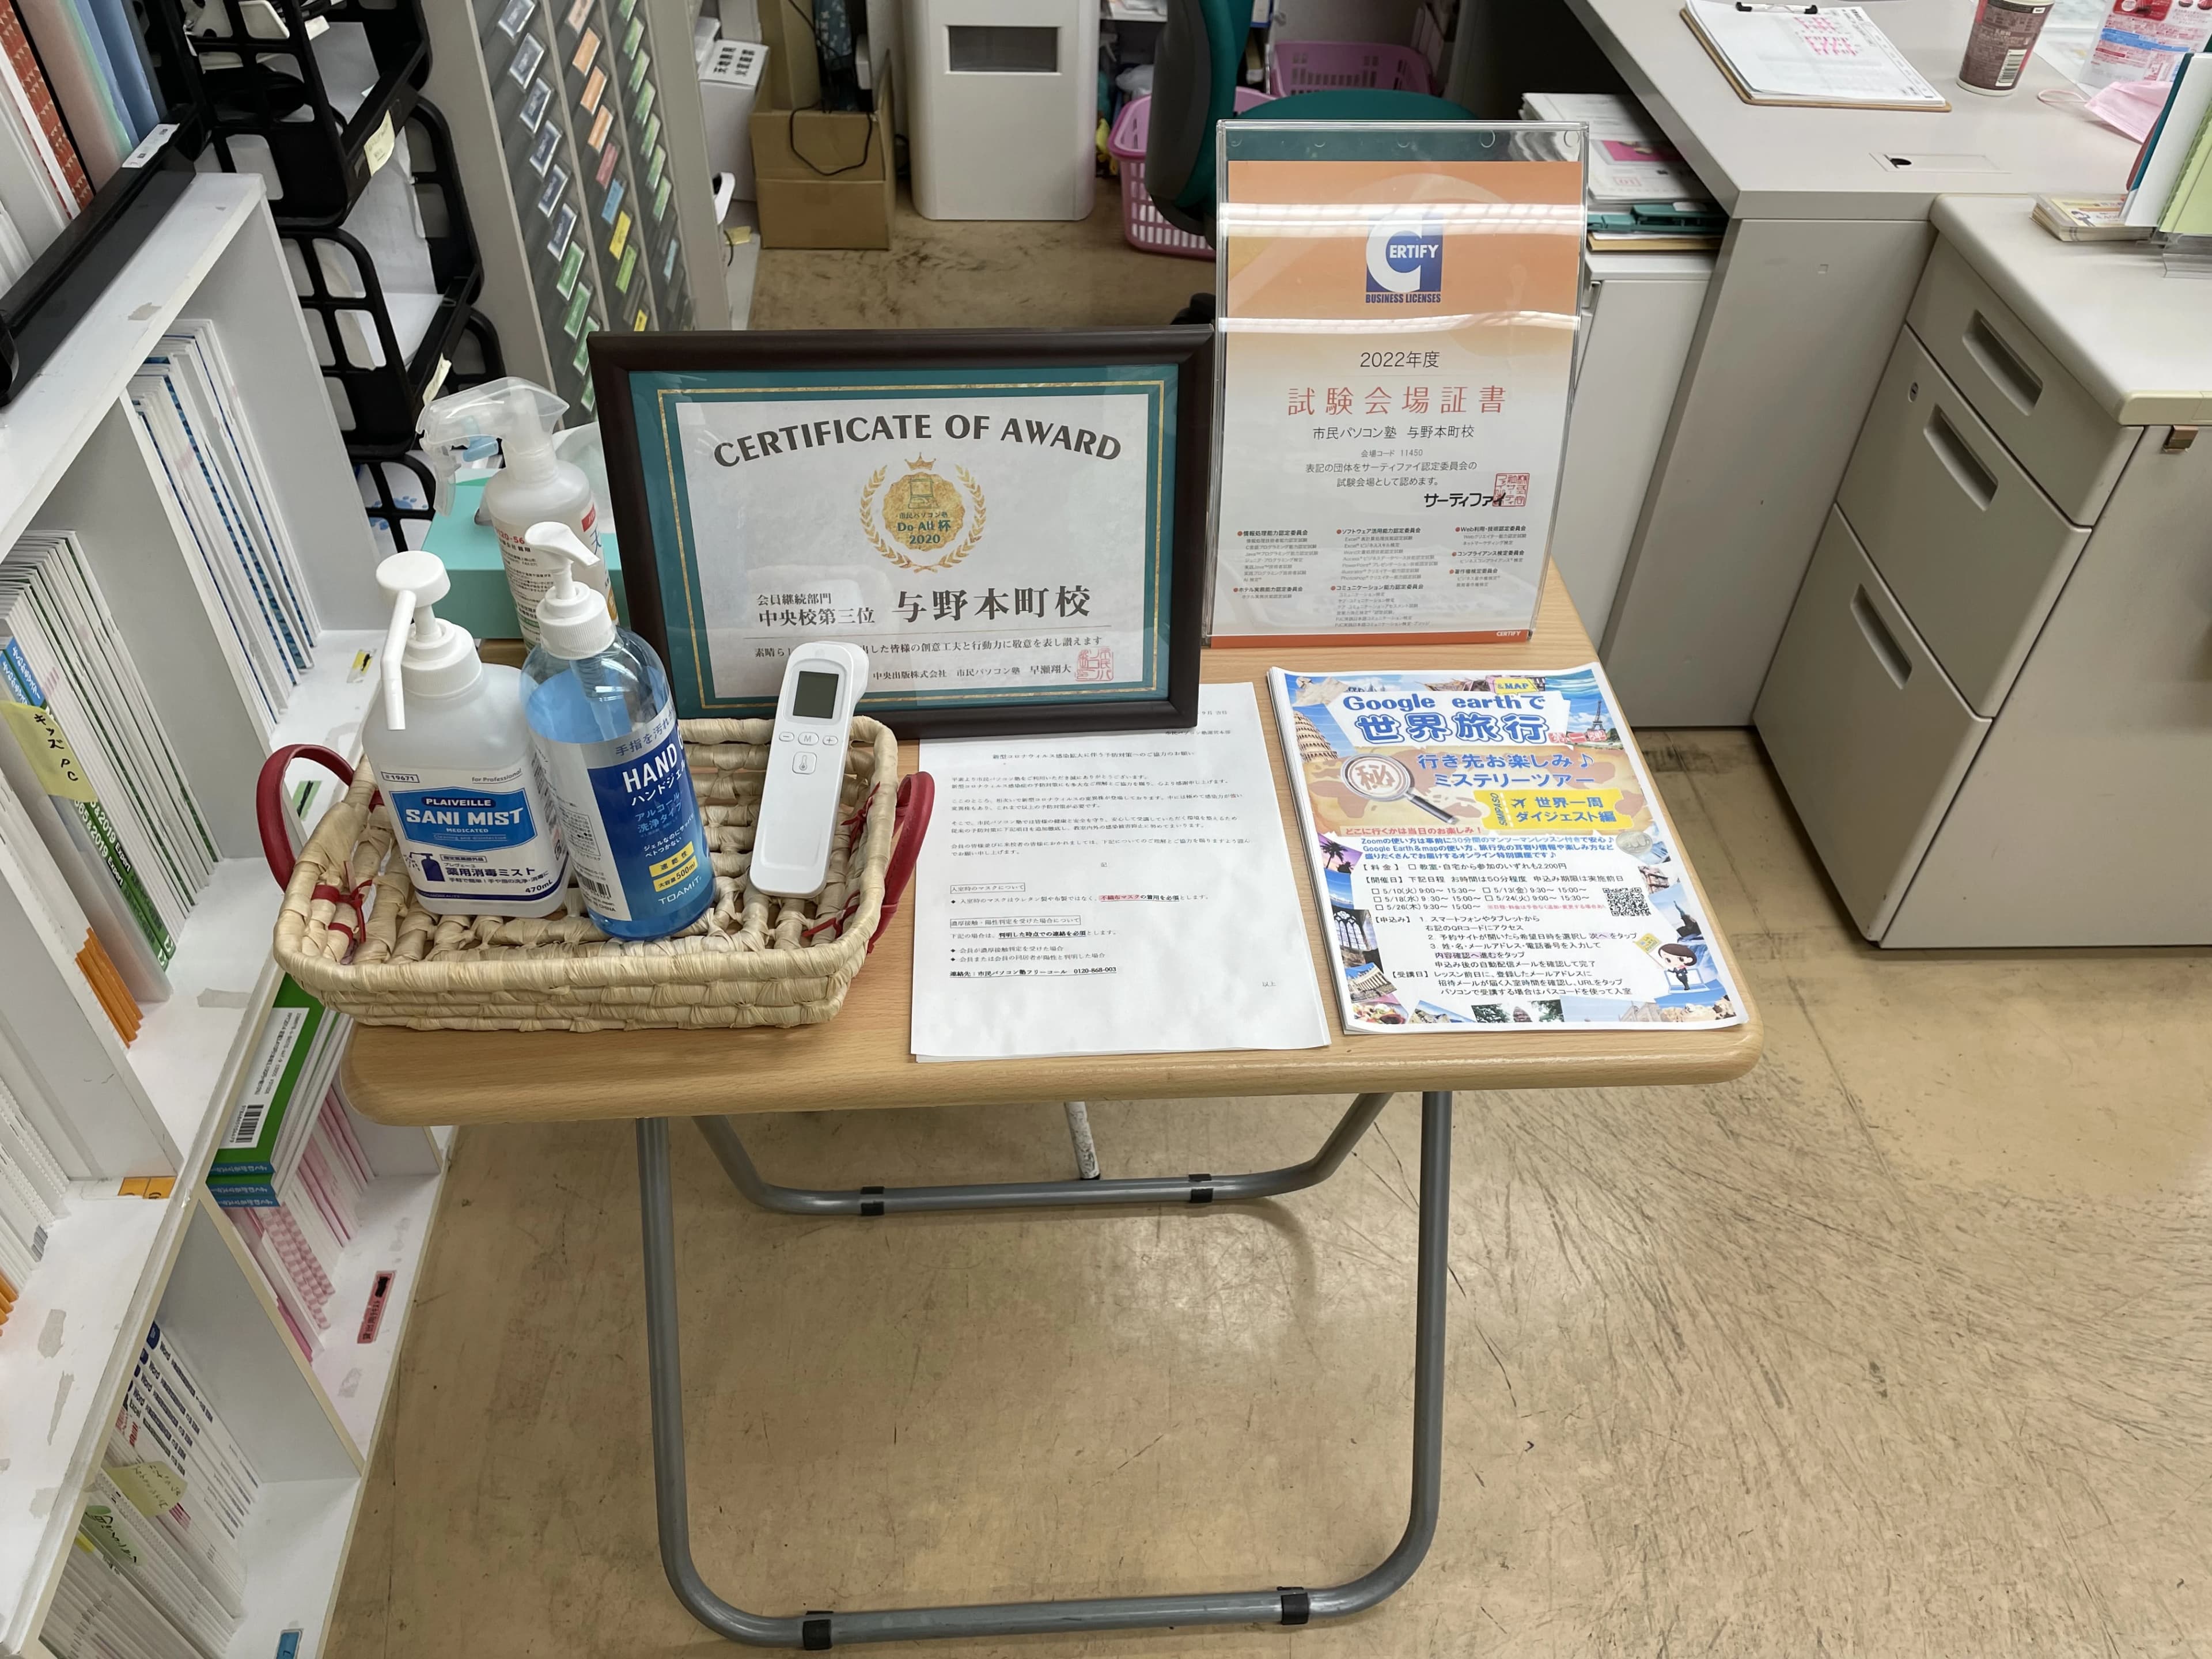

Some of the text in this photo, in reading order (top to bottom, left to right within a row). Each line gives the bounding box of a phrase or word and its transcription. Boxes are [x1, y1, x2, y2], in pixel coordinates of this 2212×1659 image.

[1366, 293, 1441, 304] BUSINESS LICENSES
[1360, 351, 1440, 369] 2022年度
[1288, 385, 1506, 416] 試験会場証書
[714, 413, 1122, 467] CERTIFICATE OF AWARD
[1313, 425, 1475, 440] 市民パソコン塾 与野本町校
[1361, 449, 1423, 457] 会場コード 11450
[1305, 461, 1478, 474] 表記の団体をサーティファイ認定委員会の
[1337, 476, 1438, 488] 試験会場として認めます。
[1424, 493, 1506, 507] サーティファイ
[897, 522, 914, 531] Do
[938, 520, 951, 532] 杯
[910, 535, 941, 544] 2020
[756, 593, 832, 606] 会員継続部門
[892, 585, 1090, 623] 与野本町校
[759, 607, 876, 627] 中央校第三位
[873, 664, 1071, 680] 中央出版株式会社 市民パソコン塾 早瀬翔大
[1343, 694, 1546, 711] Google earthで
[1355, 712, 1549, 744] 世界旅行
[34, 713, 78, 782] キッズ PC
[483, 768, 522, 782] Professional
[622, 743, 677, 793] HAND
[1355, 764, 1396, 791] 秘
[1434, 773, 1594, 788] ミステリーツアー
[426, 798, 491, 806] PLAIVEILLE
[635, 792, 681, 822] アルコール
[1535, 797, 1604, 808] 世界一周
[406, 808, 523, 825] SANI MIST
[638, 802, 682, 833] 洗浄タイプ
[1516, 811, 1617, 823] ダイジェスト編
[90, 801, 131, 872] 5&2019 Expert
[645, 837, 681, 857] ベトつかない
[108, 856, 123, 885] Expert
[446, 867, 535, 877] 薬用消毒ミスト
[676, 862, 696, 880] 500ml
[525, 879, 553, 893] 470mL
[658, 876, 700, 904] TOAMIT
[952, 884, 1024, 892] 入室時のマスクについて
[1435, 951, 1525, 959] 内容確認へ進むをタップ
[1435, 960, 1595, 968] 申込み後の自動配信メールを確認して完了
[1434, 970, 1592, 978] レッスン前日に、登録したメールアドレスに
[1441, 987, 1632, 996] パソコンで受講する場合はパスコードを使って入室
[160, 1340, 171, 1361] Word
[149, 1359, 160, 1379] Word
[141, 1372, 152, 1392] Word
[133, 1387, 145, 1406] Word
